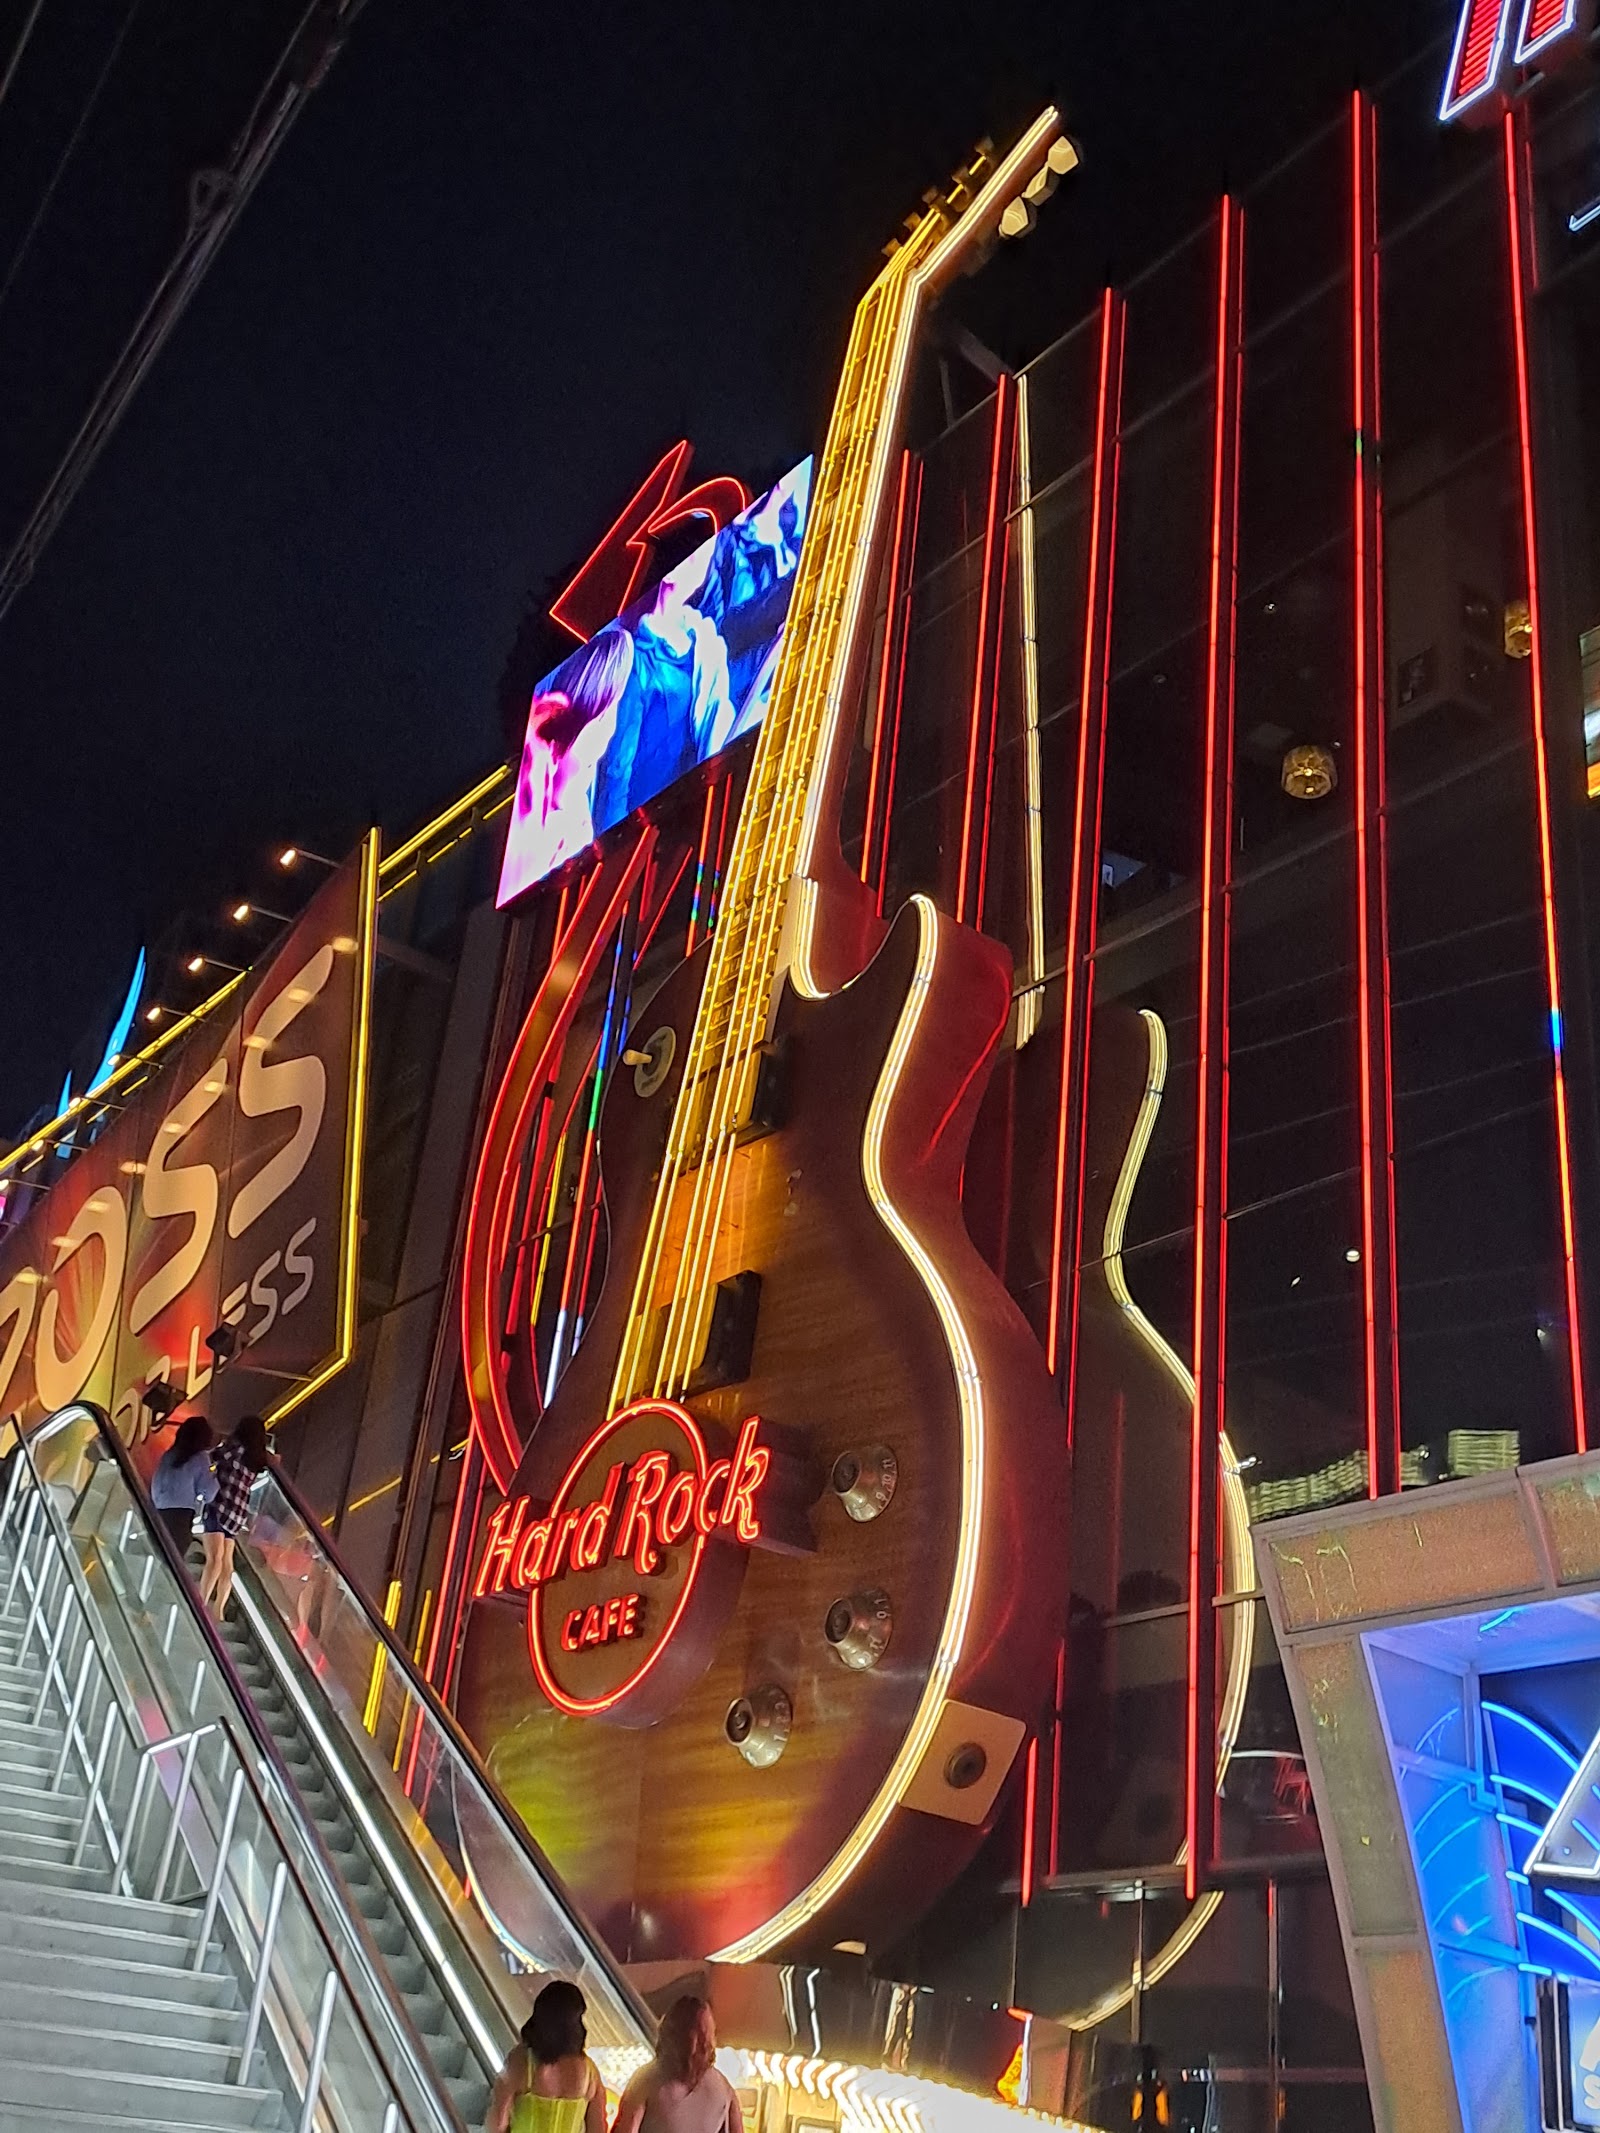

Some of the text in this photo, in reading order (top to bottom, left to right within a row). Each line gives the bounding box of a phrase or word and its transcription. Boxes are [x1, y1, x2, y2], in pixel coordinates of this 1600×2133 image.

[472, 1416, 770, 1599] Hard Rock
[561, 1593, 640, 1651] CAFE
